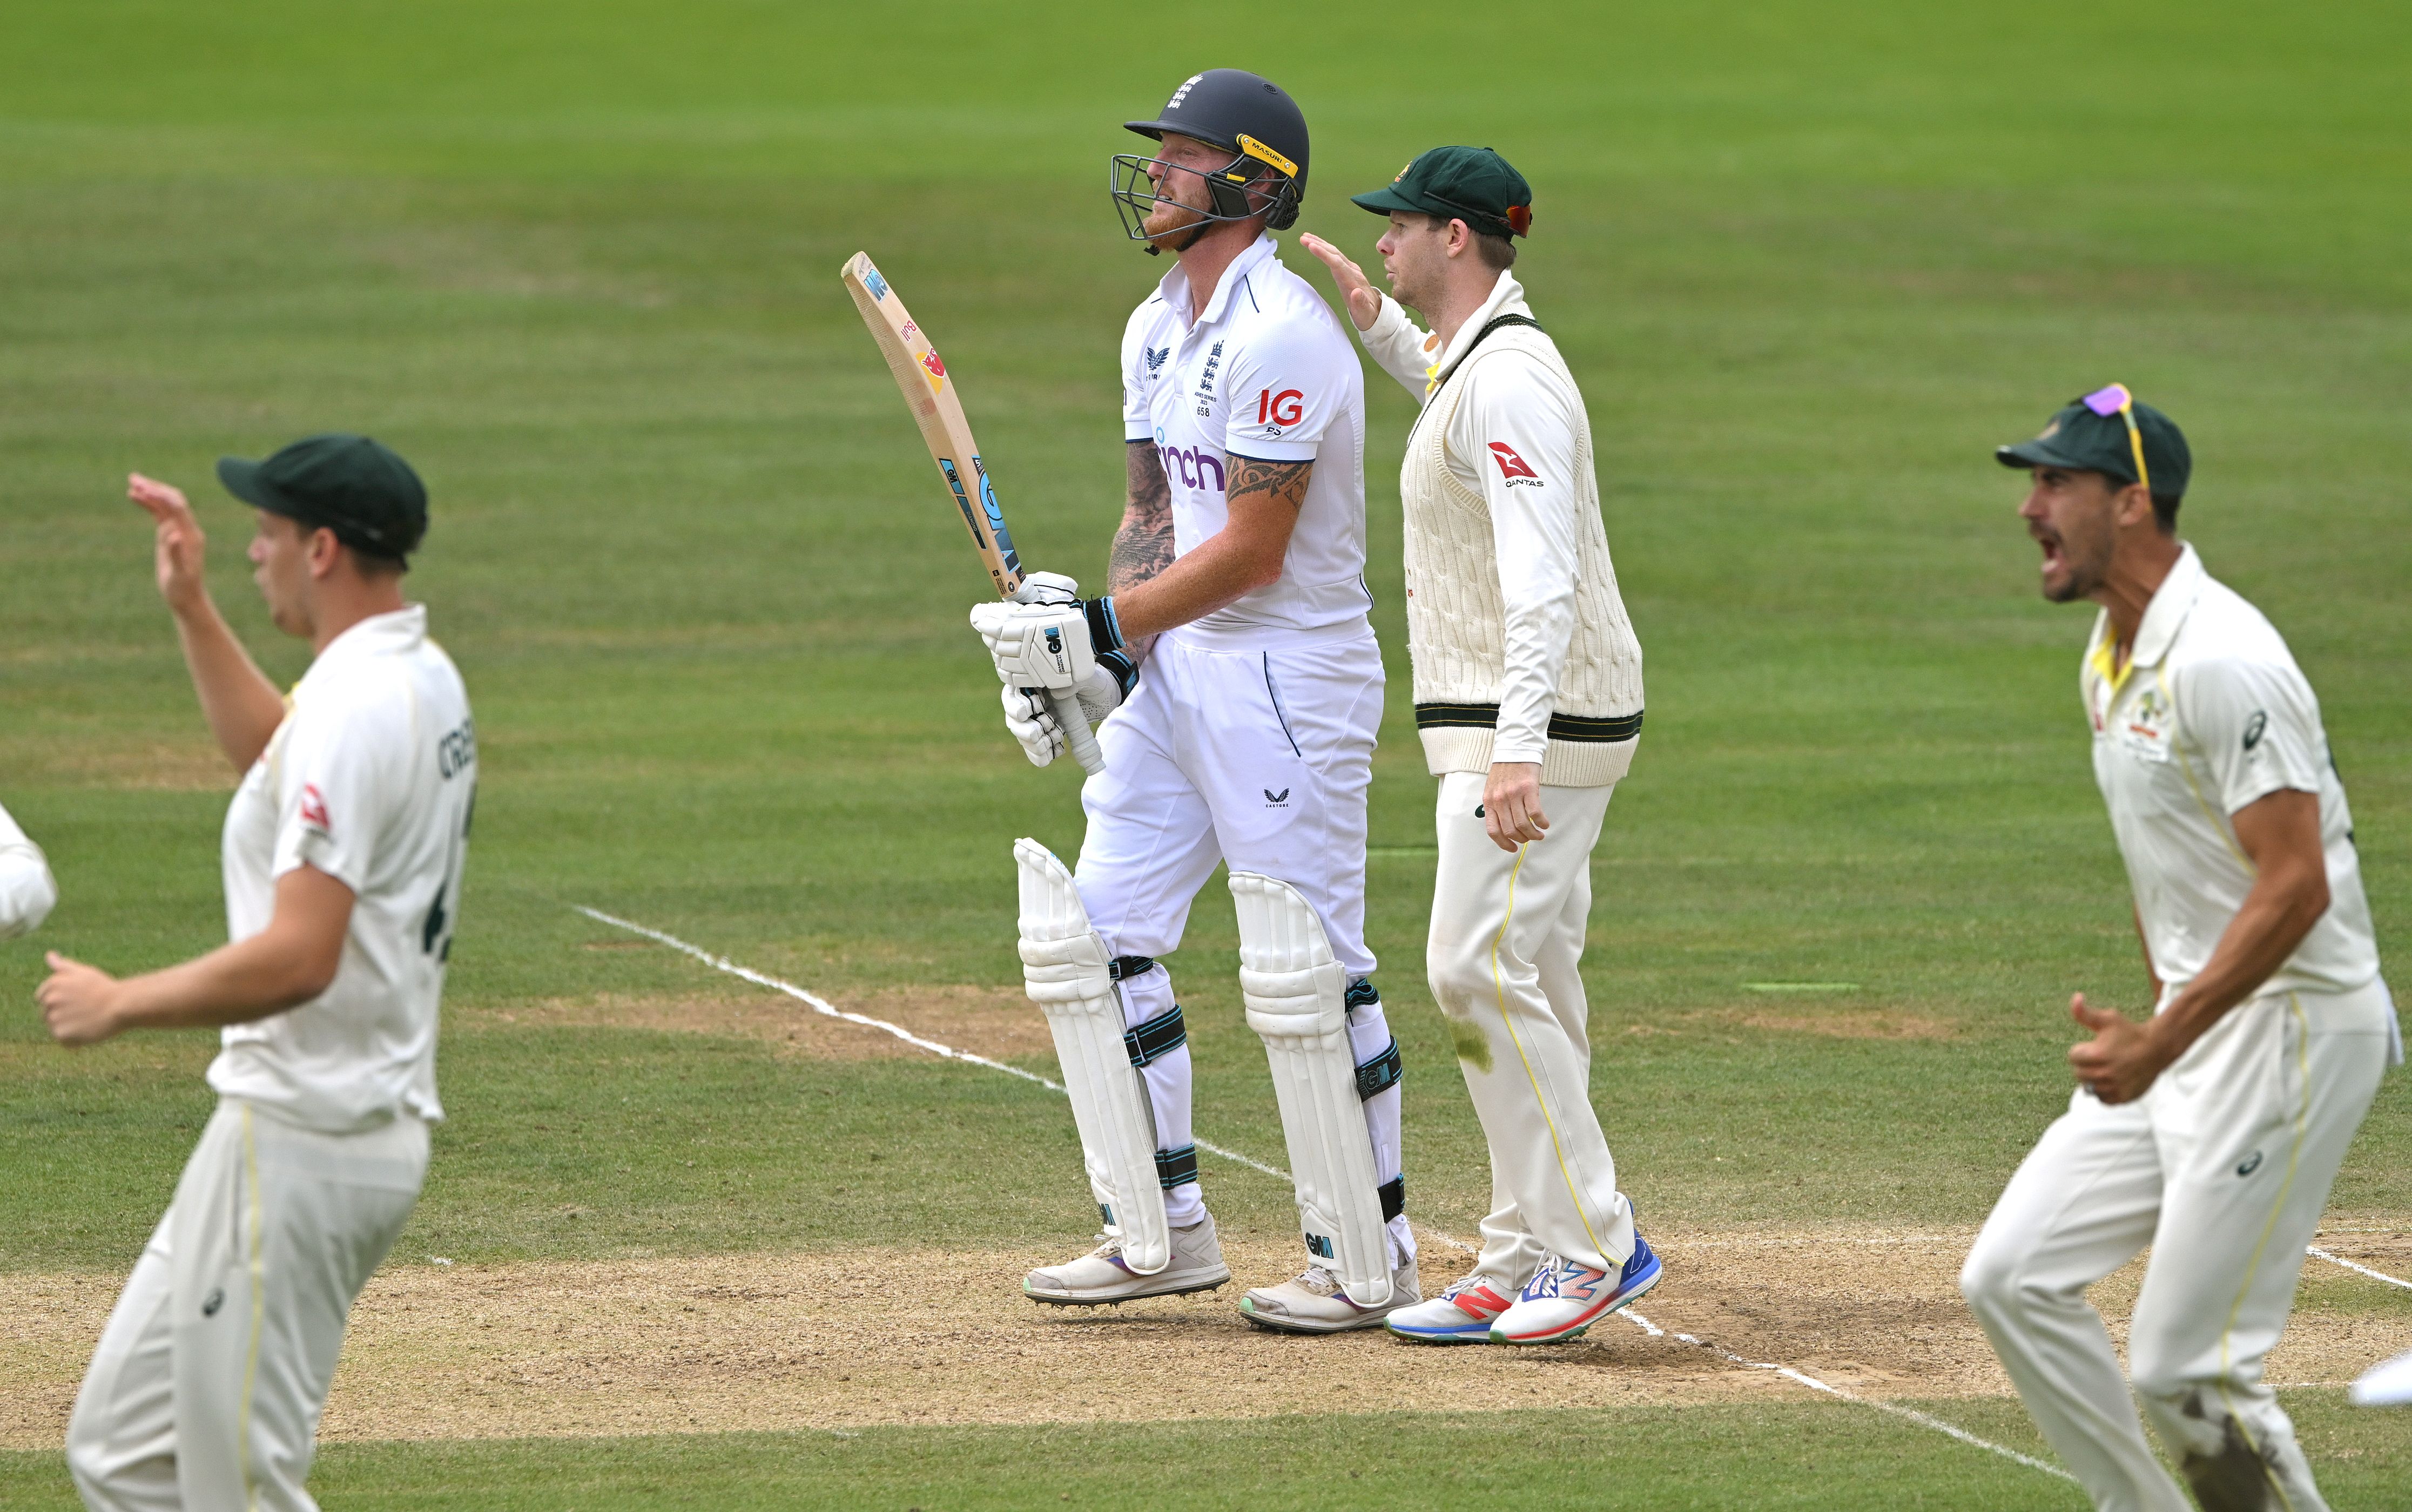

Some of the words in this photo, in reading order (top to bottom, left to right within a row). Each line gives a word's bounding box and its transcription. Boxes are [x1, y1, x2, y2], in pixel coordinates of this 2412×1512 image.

[1252, 143, 1283, 164] MASURI
[901, 320, 917, 342] Bull
[1204, 394, 1217, 402] SERIES
[1258, 389, 1304, 427] IG
[1197, 407, 1210, 417] 658
[1155, 426, 1225, 491] inch
[947, 469, 958, 483] GM
[1506, 479, 1544, 488] QANTAS
[966, 511, 978, 532] DIAMOND
[1044, 626, 1062, 654] GM
[1365, 1062, 1391, 1090] GM
[1305, 1231, 1334, 1259] GM
